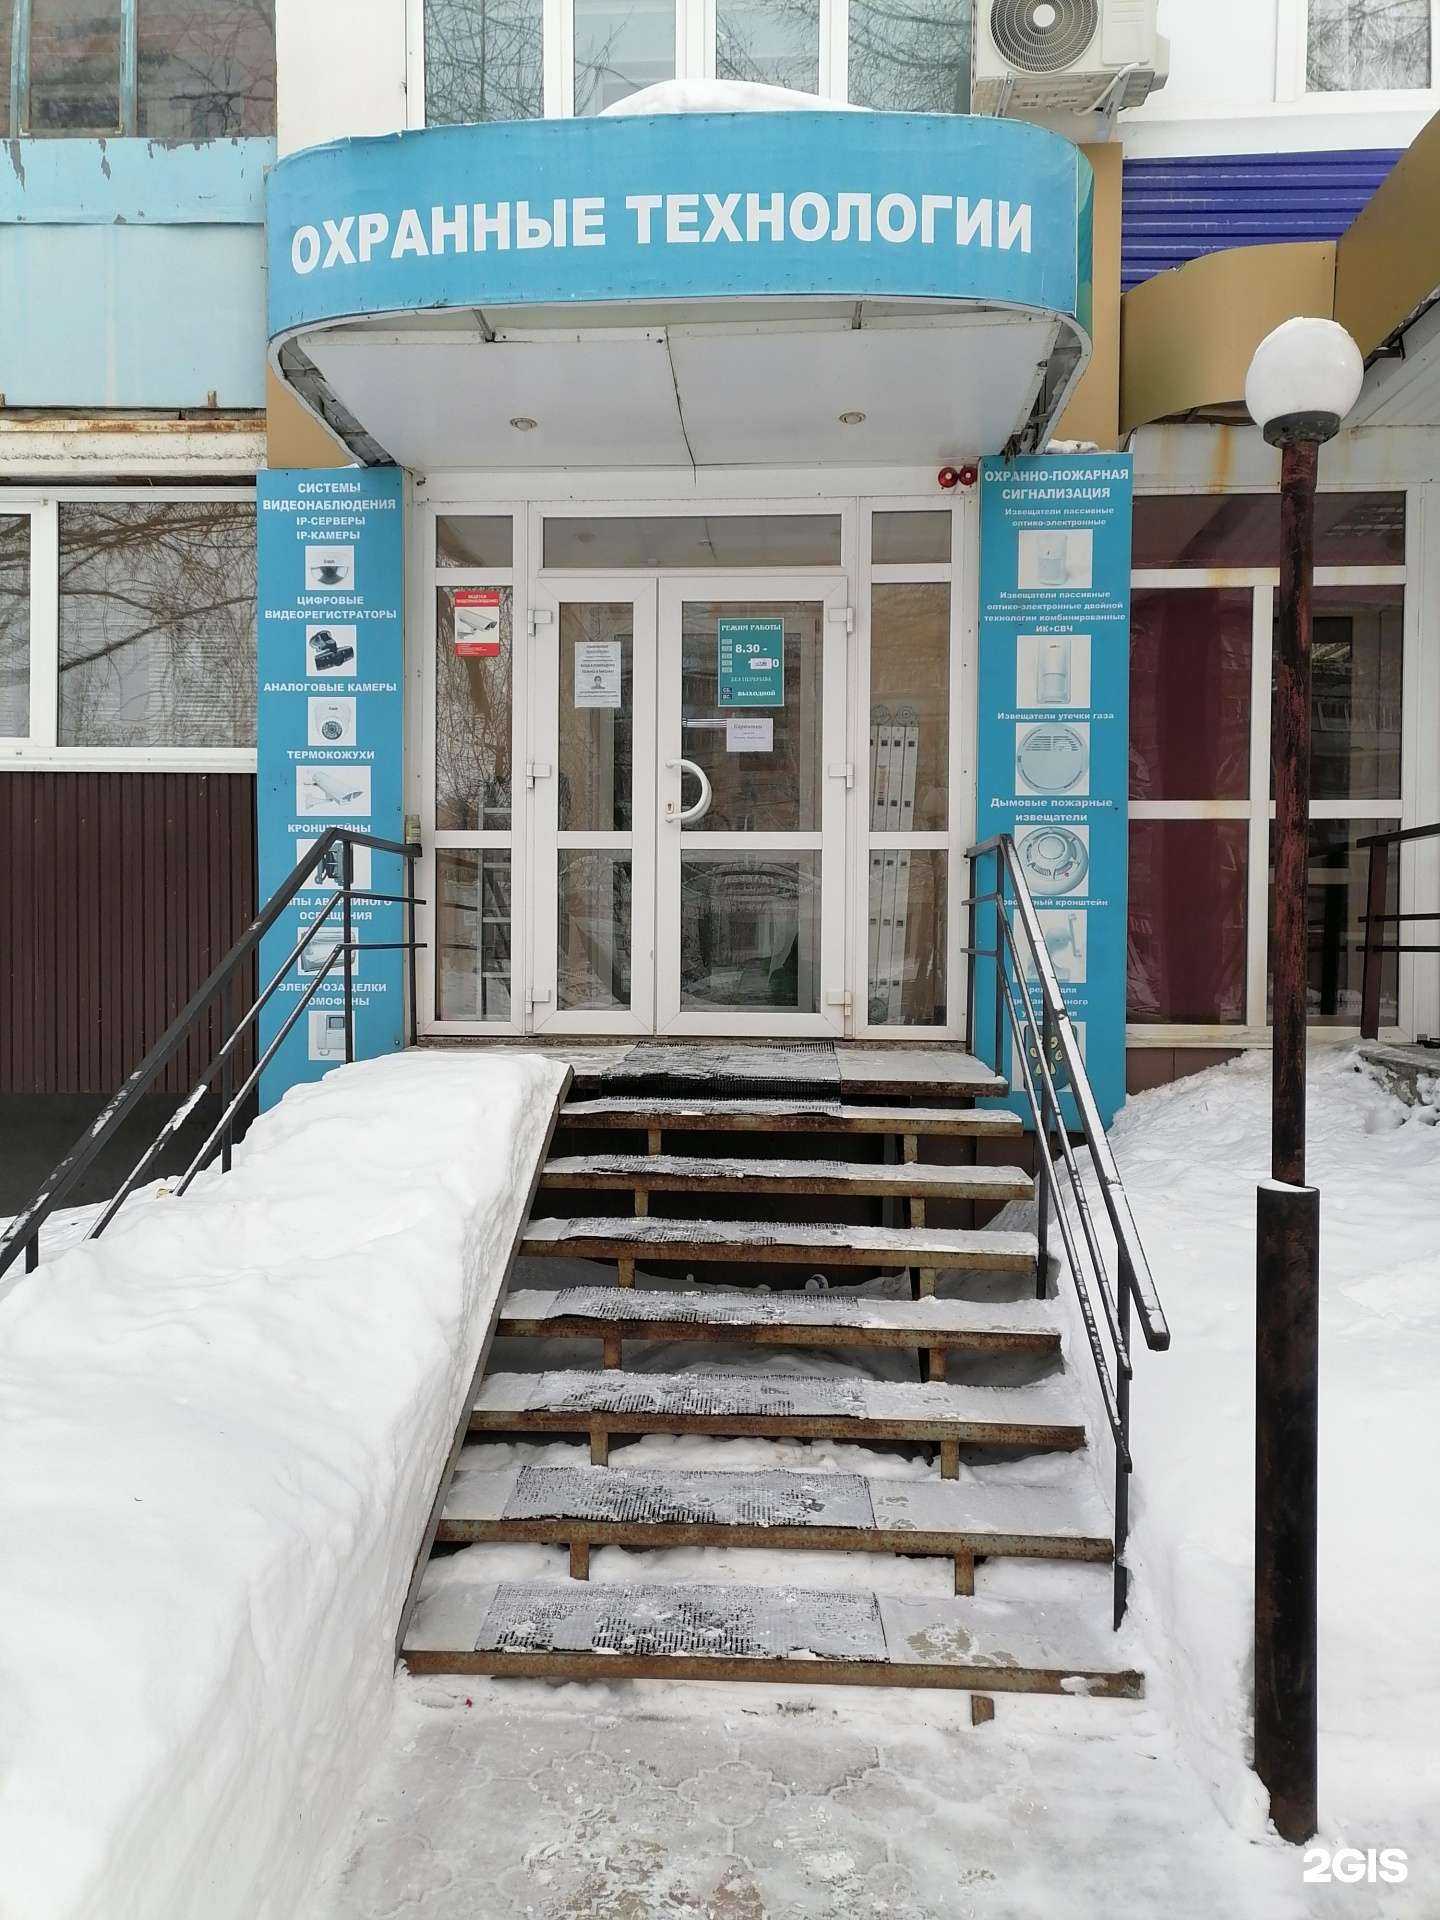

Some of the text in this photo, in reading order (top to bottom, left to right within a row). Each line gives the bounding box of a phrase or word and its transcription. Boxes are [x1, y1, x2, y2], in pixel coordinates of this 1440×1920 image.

[291, 191, 1033, 275] ОХРАННЫЕ ТЕХНОЛОГИИ
[984, 468, 1129, 482] ОХРАННО-ПОЖАРНАЯ
[297, 482, 361, 493] СИСТЕМЫ
[1001, 487, 1111, 500] СИГНАЛИЗАЦИЯ
[262, 499, 396, 511] ВИДЕОНАБЛЮДЕНИЯ
[1004, 507, 1115, 516] Извещатели пассивные
[296, 516, 366, 526] IP-СЕРВЕРЫ
[296, 530, 361, 540] IP-КАМЕРЫ
[999, 591, 1111, 600] Извещатели пассивные
[296, 596, 365, 606] ЦИФРОВЫЕ
[264, 609, 397, 620] ВИДЕОРЕГИСТРАТОРЫ
[1035, 625, 1074, 633] ИК+СВЧ
[735, 643, 760, 653] 8.30
[263, 682, 397, 692] АНАЛОГОВЫЕ КАМЕРЫ
[997, 711, 1056, 720] Извещатели
[1058, 712, 1091, 720] утечки
[286, 750, 376, 760] ТЕРМОКОЖУХИ
[990, 798, 1113, 809] Дымовые пожарные
[1015, 813, 1088, 822] извещатели
[1055, 898, 1109, 907] кронштейн
